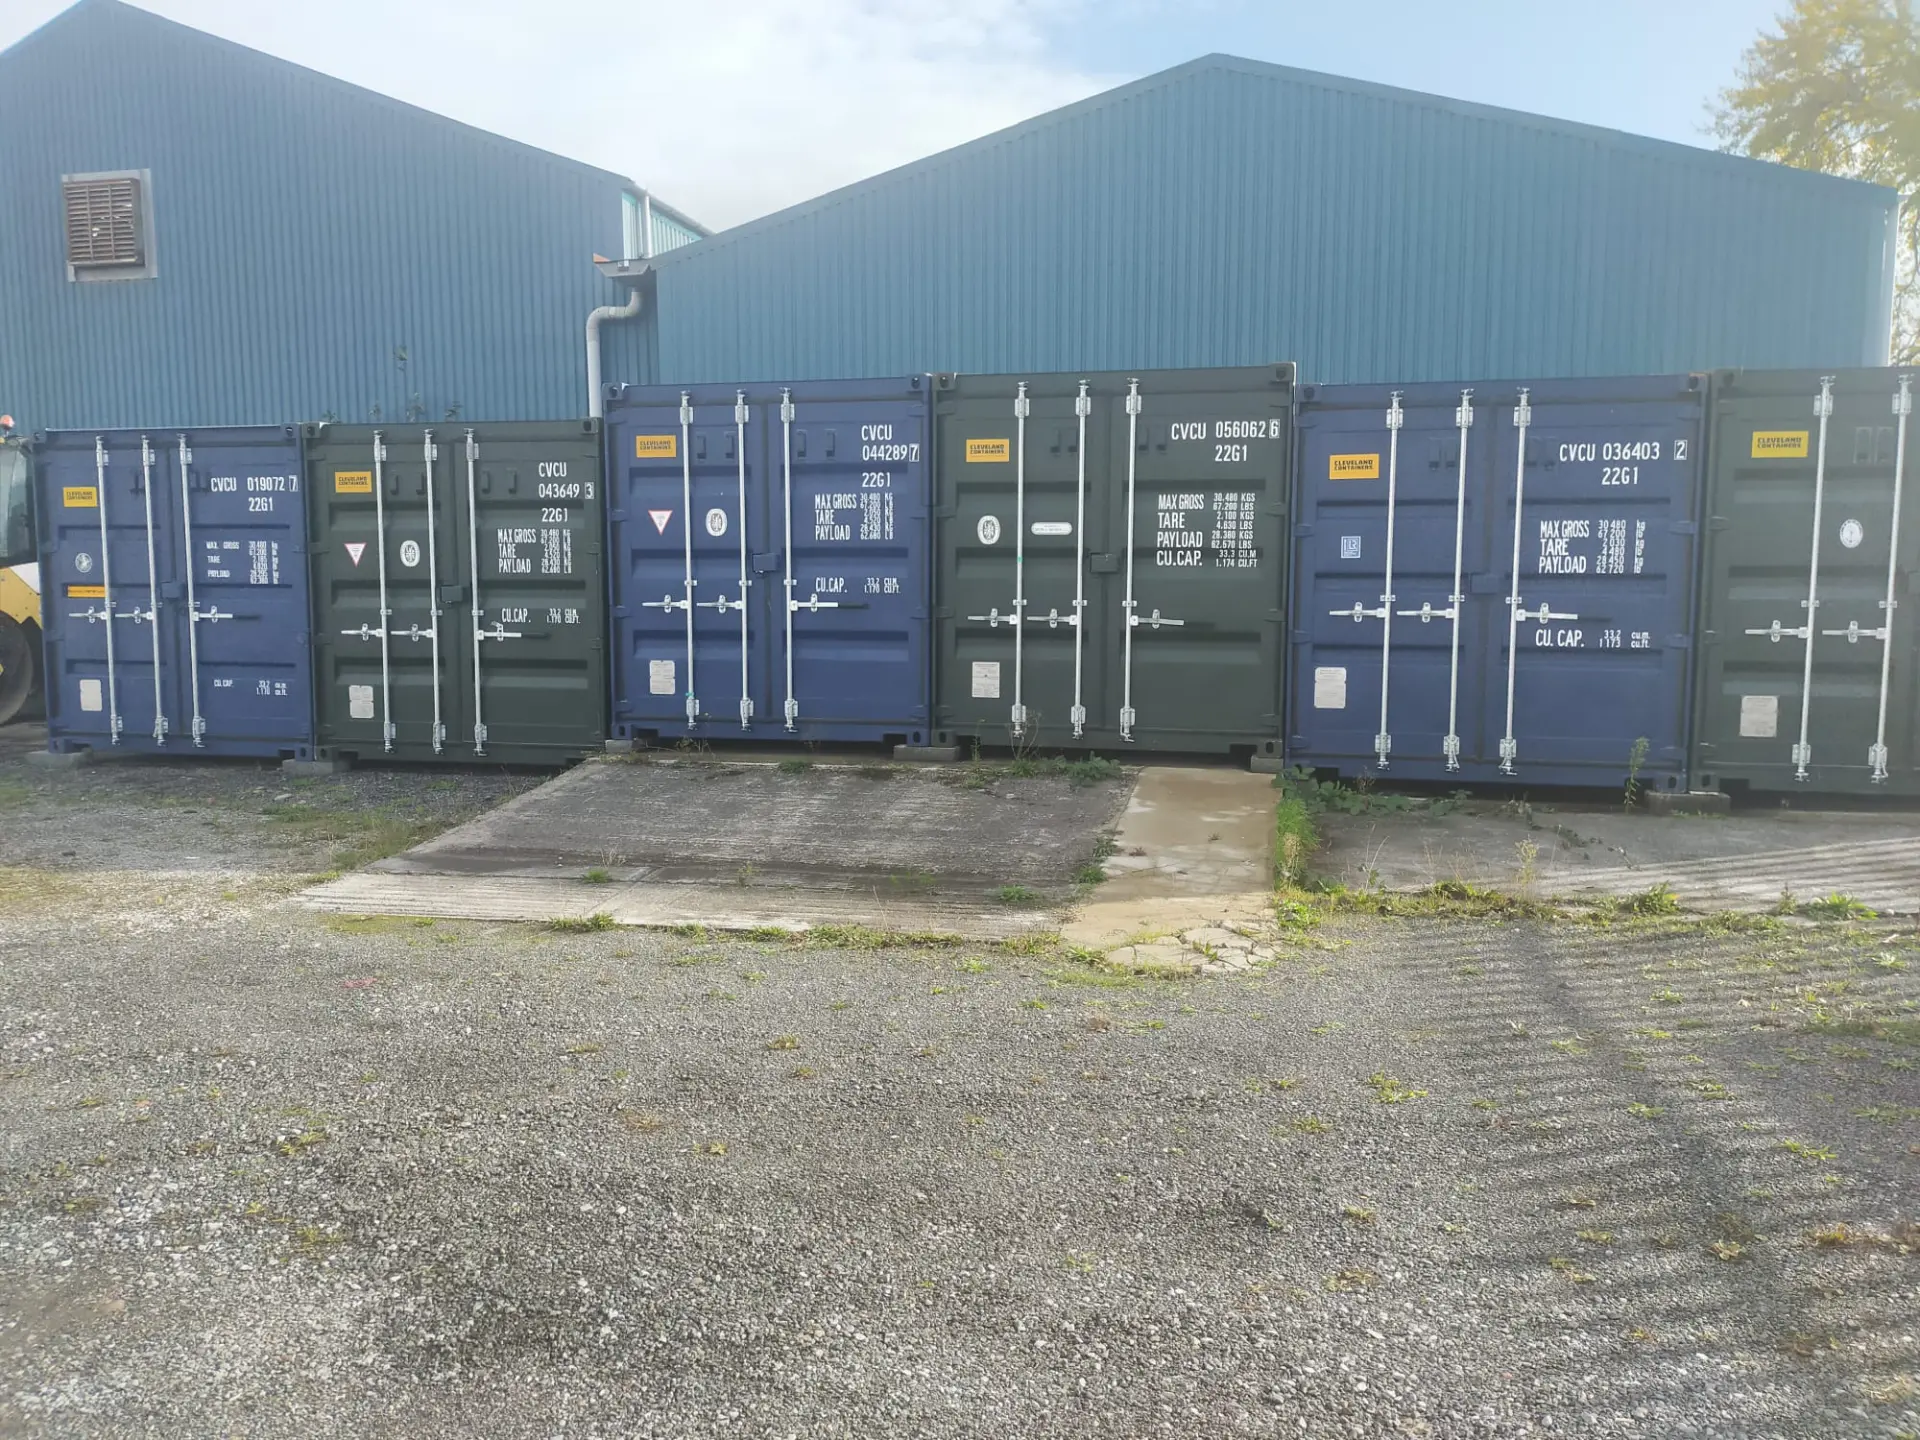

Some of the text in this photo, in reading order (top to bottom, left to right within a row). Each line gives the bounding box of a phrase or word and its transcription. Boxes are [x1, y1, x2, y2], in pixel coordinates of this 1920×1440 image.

[861, 424, 892, 441] CVCU
[1171, 419, 1280, 440] CVCU 056062 6
[862, 444, 919, 461] 044289 7
[1215, 445, 1247, 461] 22G1
[1559, 440, 1687, 461] CVCU 036403 2
[539, 462, 567, 477] CVCU
[1601, 467, 1638, 485] 22G1
[211, 476, 298, 492] CVCU 019072 7
[862, 473, 891, 488] 22G1
[539, 482, 594, 499] 043649 3
[248, 497, 273, 511] 22G1
[815, 494, 831, 509] MAX
[833, 494, 857, 509] GROSS
[1158, 494, 1177, 510] MAX
[1178, 494, 1204, 510] GROSS
[1241, 492, 1255, 501] KGS
[541, 508, 568, 522] 22G1
[816, 509, 834, 525] TARE
[1158, 512, 1185, 529] TARE
[1240, 511, 1254, 520] KGS
[815, 525, 851, 540] PAYLOAD
[1240, 521, 1253, 529] LBS
[1540, 520, 1560, 538] MAX
[1562, 520, 1589, 538] GROSS
[1157, 531, 1203, 548] PAYLOAD
[1239, 530, 1253, 539] KGS
[1239, 540, 1252, 548] LBS
[499, 544, 516, 558] TARE
[1219, 549, 1235, 557] 33.3
[1540, 539, 1569, 556] TARE
[498, 559, 532, 573] PAYLOAD
[1216, 558, 1235, 567] 1.174
[1539, 556, 1586, 573] PAYLOAD
